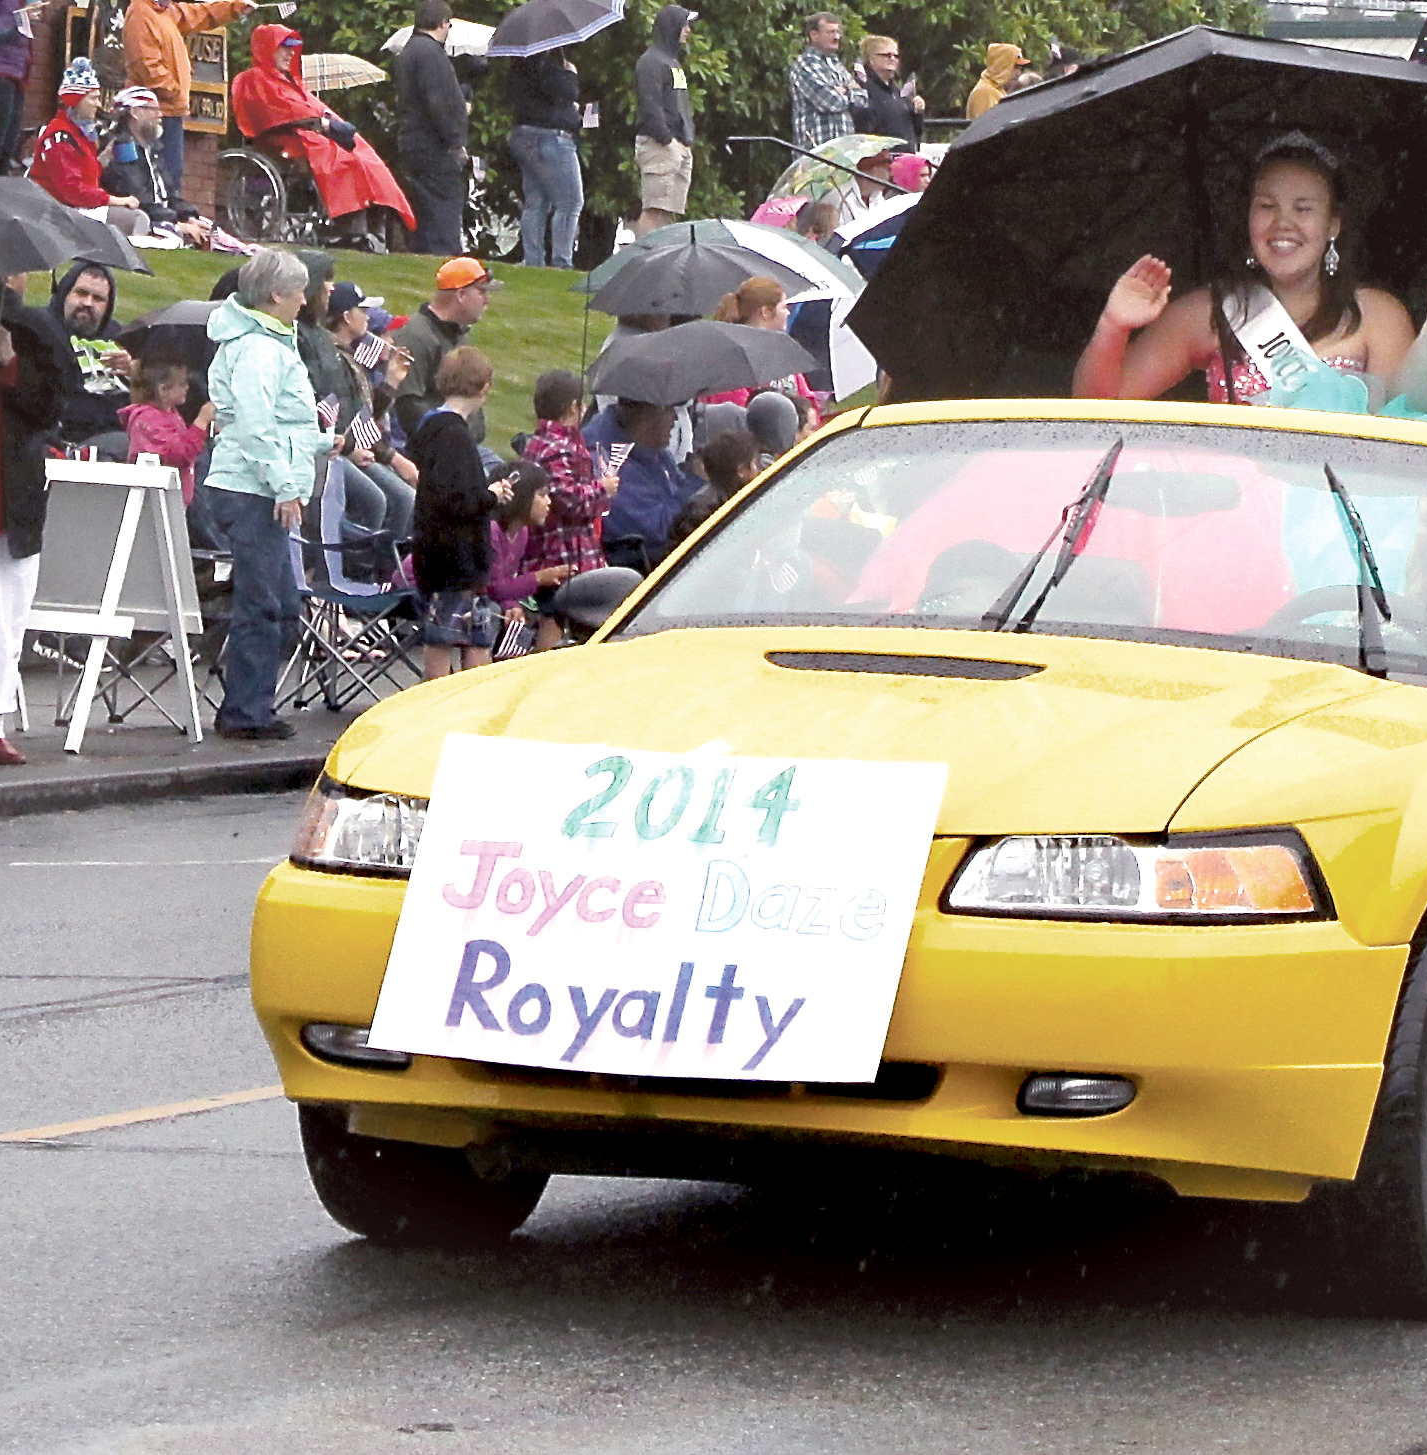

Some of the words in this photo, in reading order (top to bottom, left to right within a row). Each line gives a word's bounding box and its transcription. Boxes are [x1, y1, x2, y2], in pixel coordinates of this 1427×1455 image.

[561, 755, 800, 846] 2014
[441, 839, 667, 937] Joyce
[694, 858, 887, 940] Daze
[444, 939, 807, 1071] Royalty
